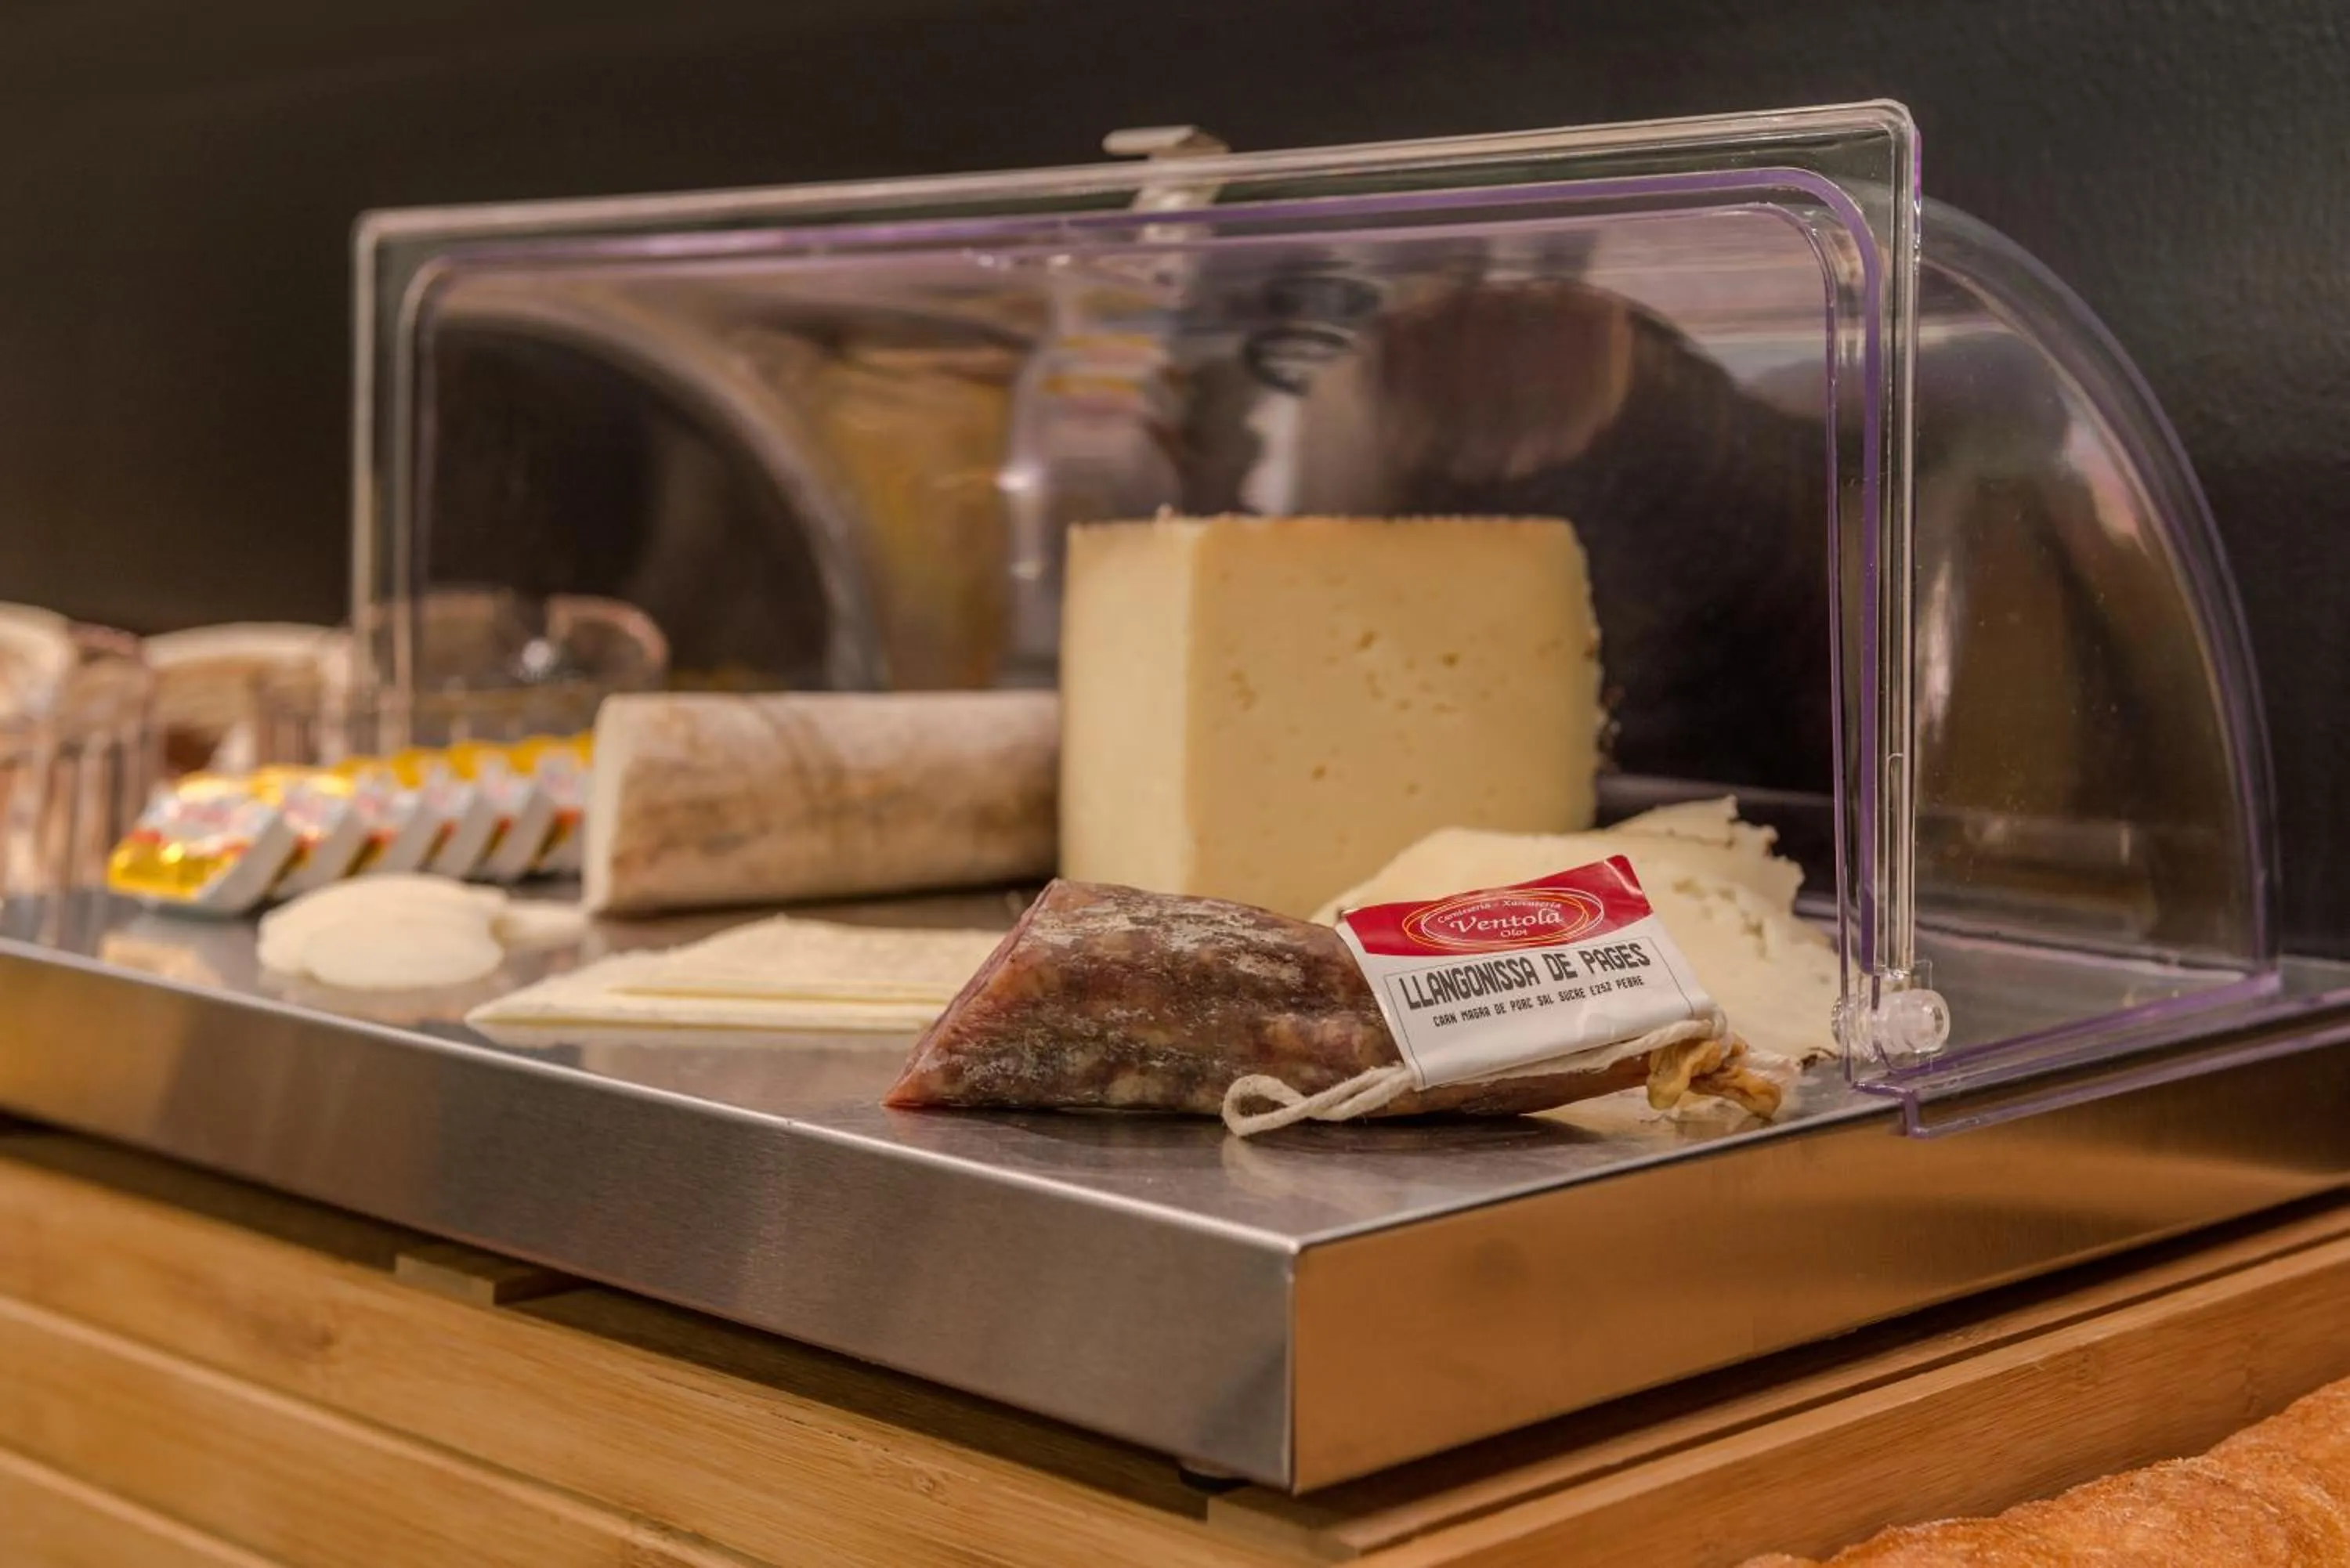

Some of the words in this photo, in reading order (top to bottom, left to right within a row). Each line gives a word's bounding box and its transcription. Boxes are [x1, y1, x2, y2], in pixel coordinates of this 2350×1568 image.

[1399, 957, 1541, 1010] LLANGONISSA
[1541, 953, 1578, 981] DE
[1578, 943, 1650, 974] PAGES
[1433, 1013, 1458, 1028] CARN
[1460, 1006, 1491, 1021] MAGRA
[1494, 1003, 1507, 1015] DE
[1509, 998, 1533, 1012] PORC
[1536, 995, 1554, 1006] SAL
[1557, 988, 1586, 1002] SUCRE
[1616, 976, 1644, 989] PEBRE
